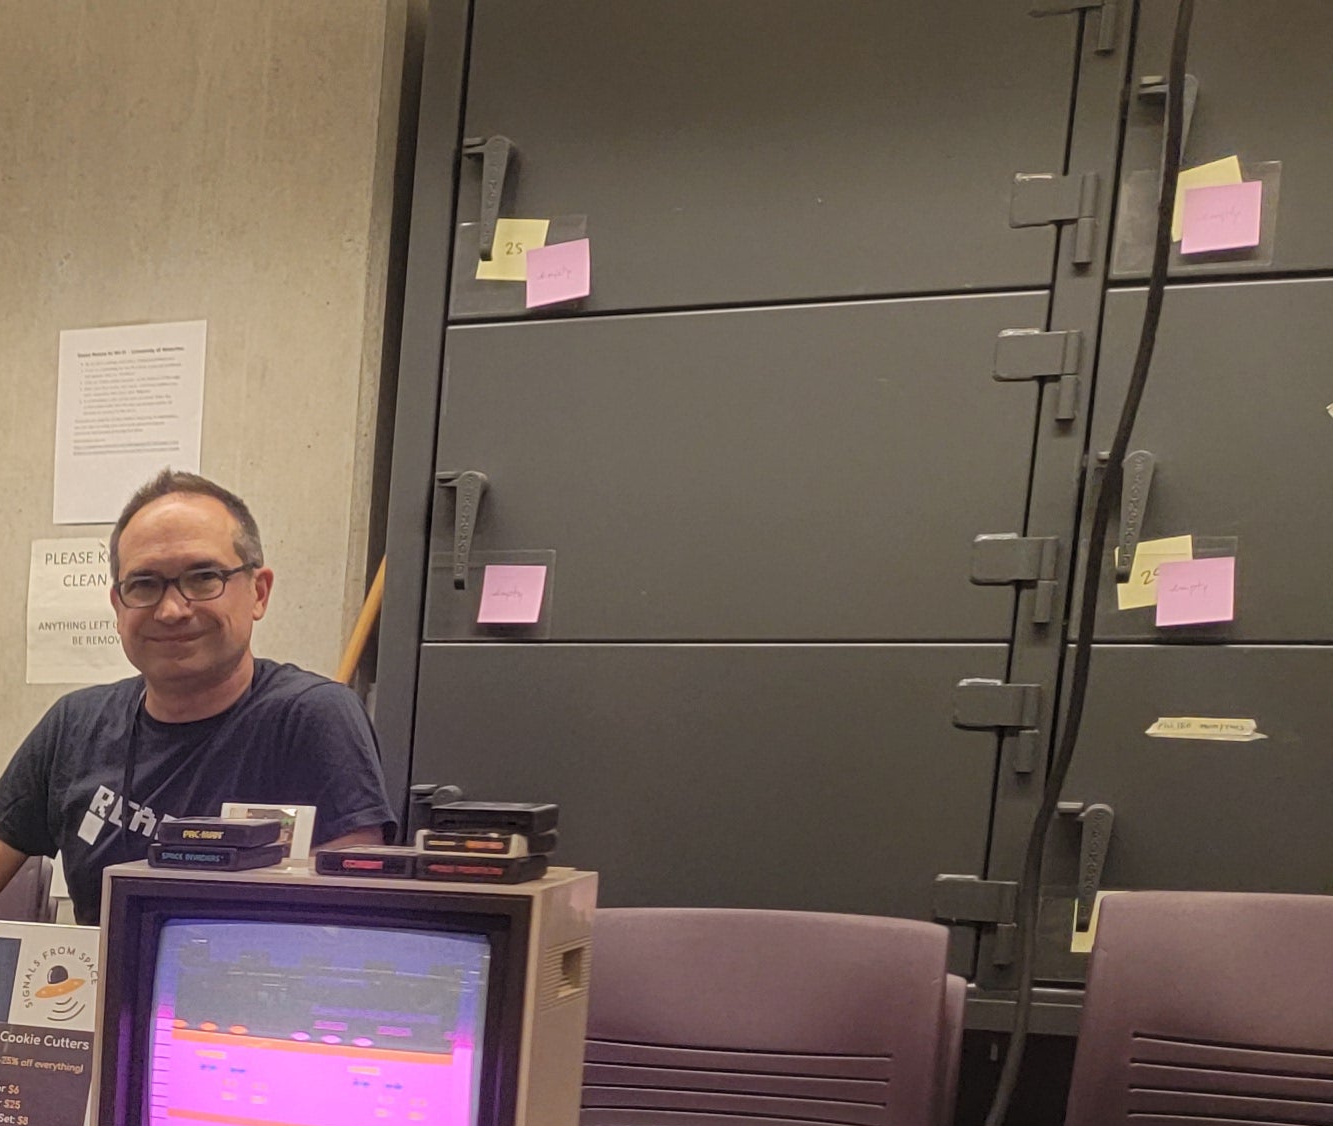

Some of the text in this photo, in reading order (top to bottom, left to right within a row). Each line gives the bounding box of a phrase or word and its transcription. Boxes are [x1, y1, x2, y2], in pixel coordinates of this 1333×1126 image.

[505, 242, 523, 255] 25
[45, 552, 110, 565] PLEASE K
[63, 573, 107, 587] CLEAN
[38, 621, 86, 631] ANYTHING
[89, 620, 110, 630] LEFT
[72, 635, 121, 645] BE REMOV
[22, 946, 99, 1009] SIGNALS FROM SPACE
[0, 1030, 41, 1045] Cookie
[44, 1034, 90, 1050] Cutters
[20, 1058, 34, 1067] off
[34, 1060, 84, 1074] everything!
[8, 1084, 20, 1095] $6
[3, 1099, 21, 1110] $25
[17, 1115, 29, 1126] $8
